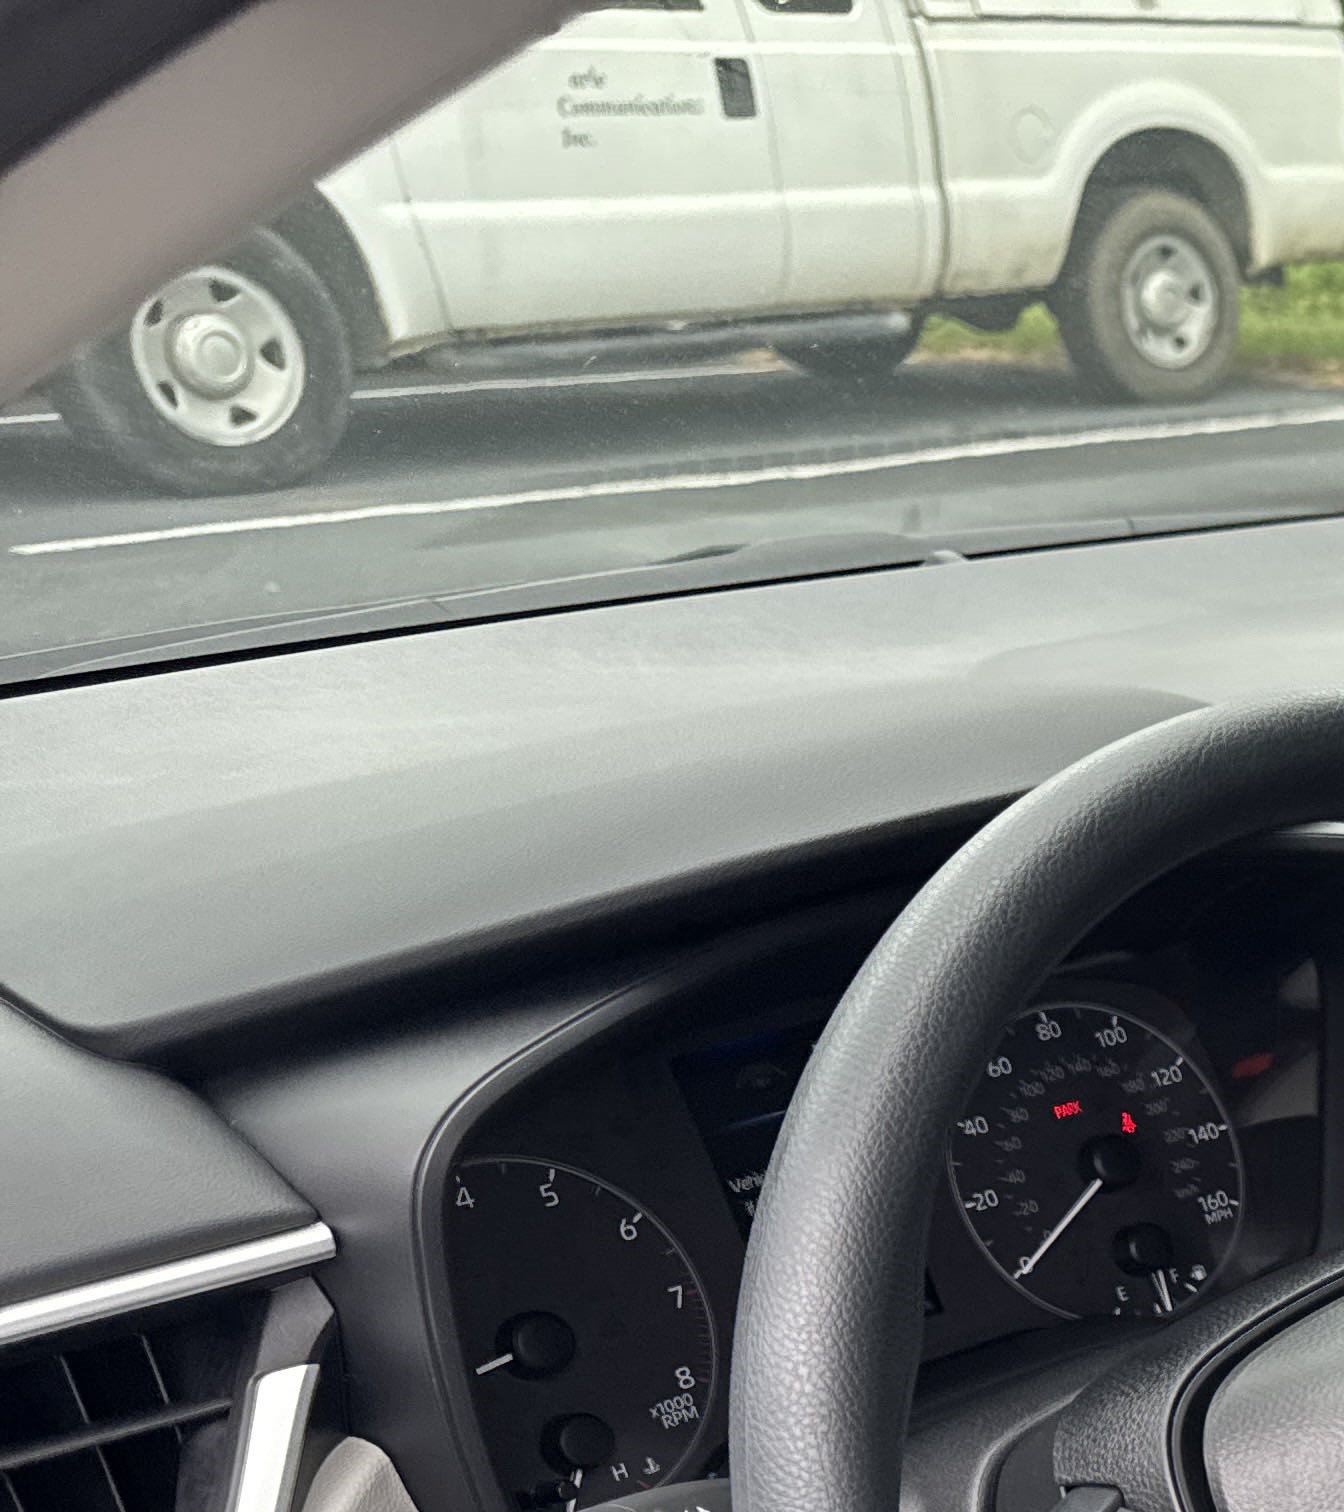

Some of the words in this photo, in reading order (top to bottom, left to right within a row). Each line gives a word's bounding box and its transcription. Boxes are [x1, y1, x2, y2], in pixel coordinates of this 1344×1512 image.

[1035, 1020, 1062, 1042] 80
[1095, 1027, 1128, 1048] 100
[987, 1057, 1012, 1078] 60
[1152, 1065, 1184, 1088] 120
[962, 1116, 989, 1137] 40
[1188, 1122, 1220, 1144] 140
[455, 1186, 475, 1208] 4
[540, 1183, 559, 1207] 5
[973, 1189, 999, 1211] 20
[1198, 1190, 1229, 1212] 160
[1205, 1208, 1233, 1225] MPH
[619, 1218, 638, 1241] 6
[667, 1285, 683, 1309] 7
[1115, 1285, 1129, 1302] E
[674, 1366, 696, 1390] 8
[649, 1393, 694, 1419] x1000
[661, 1408, 700, 1429] RPM
[611, 1462, 629, 1482] H
